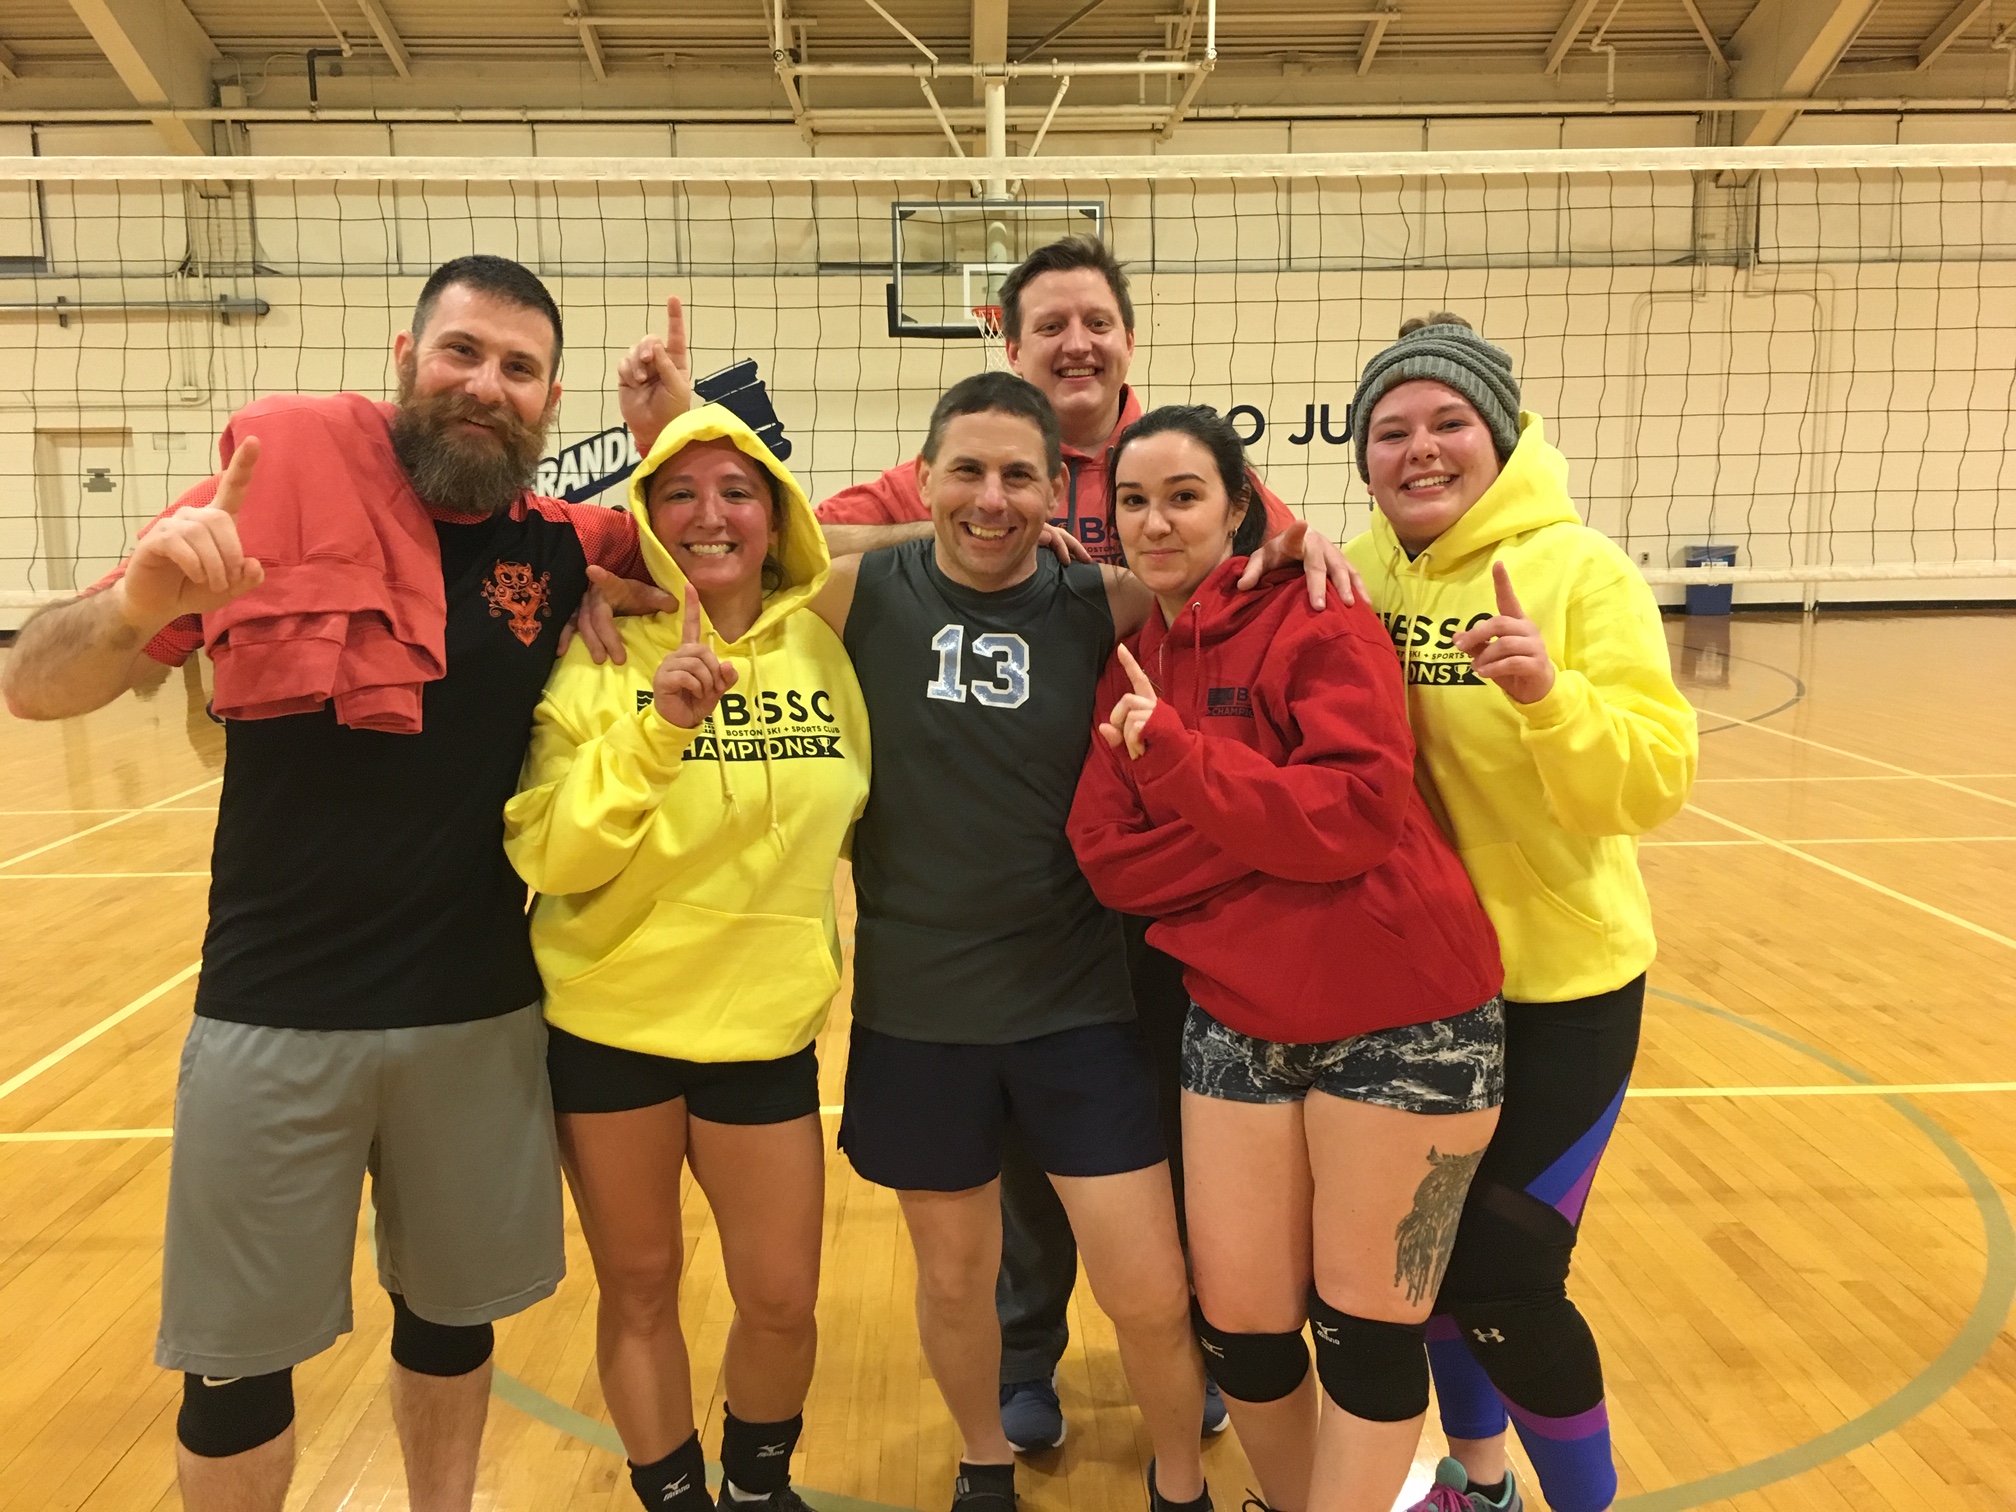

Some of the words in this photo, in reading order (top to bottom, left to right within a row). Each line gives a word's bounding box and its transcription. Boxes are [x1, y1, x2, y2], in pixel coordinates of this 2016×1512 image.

[927, 624, 1030, 709] 13
[1432, 652, 1464, 660] SPORTS
[720, 690, 835, 726] BSSC
[726, 729, 763, 737] BOSTON
[767, 727, 780, 735] SKI
[823, 725, 840, 734] CLUB
[684, 737, 818, 759] HAMPIONS
